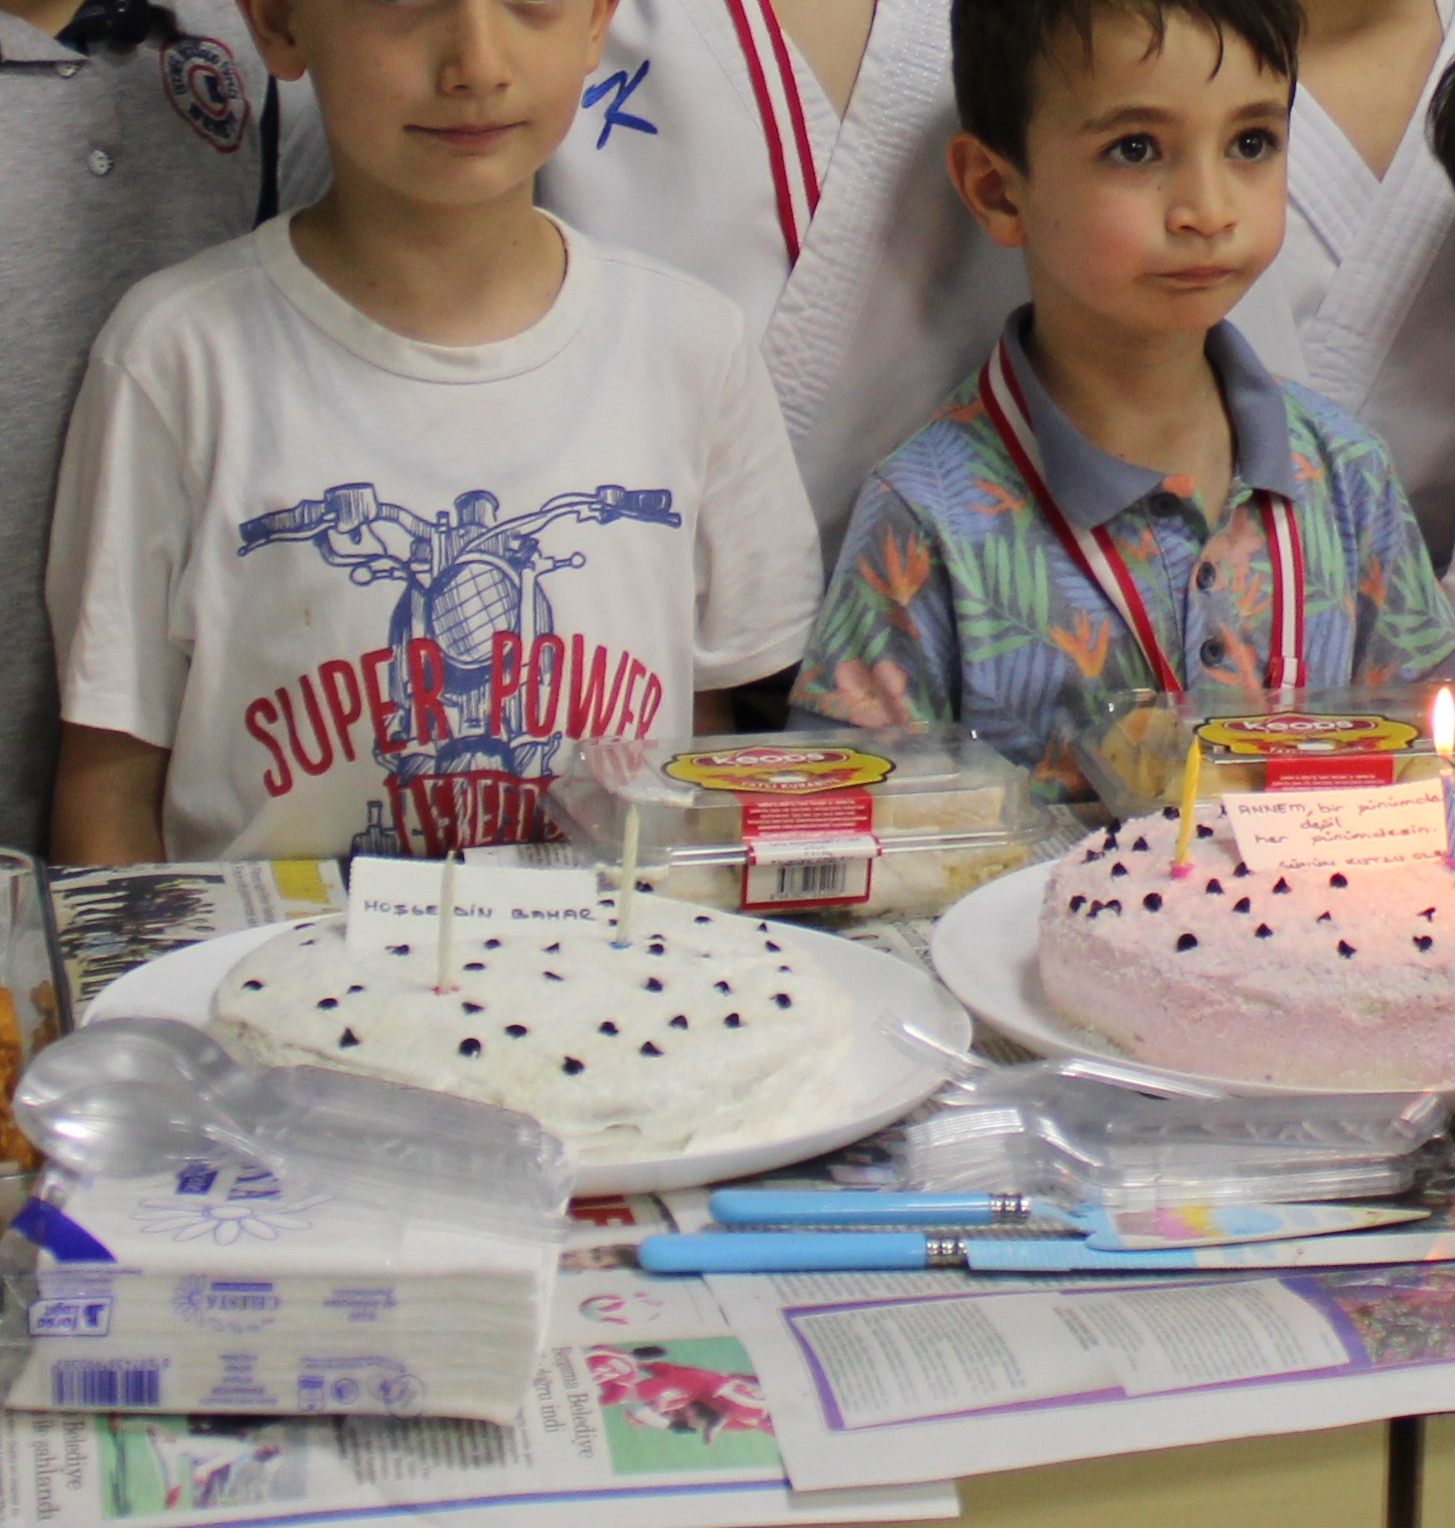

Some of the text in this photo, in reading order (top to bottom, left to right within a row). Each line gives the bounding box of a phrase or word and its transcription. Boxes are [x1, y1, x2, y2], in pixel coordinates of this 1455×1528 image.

[245, 629, 663, 798] SUPER POWER
[423, 777, 559, 847] FREED
[363, 900, 597, 921] HOŞGEDİN BAHAR
[540, 1404, 567, 1433] indi
[567, 1393, 597, 1459] Belediye
[63, 1418, 88, 1490] Belediye
